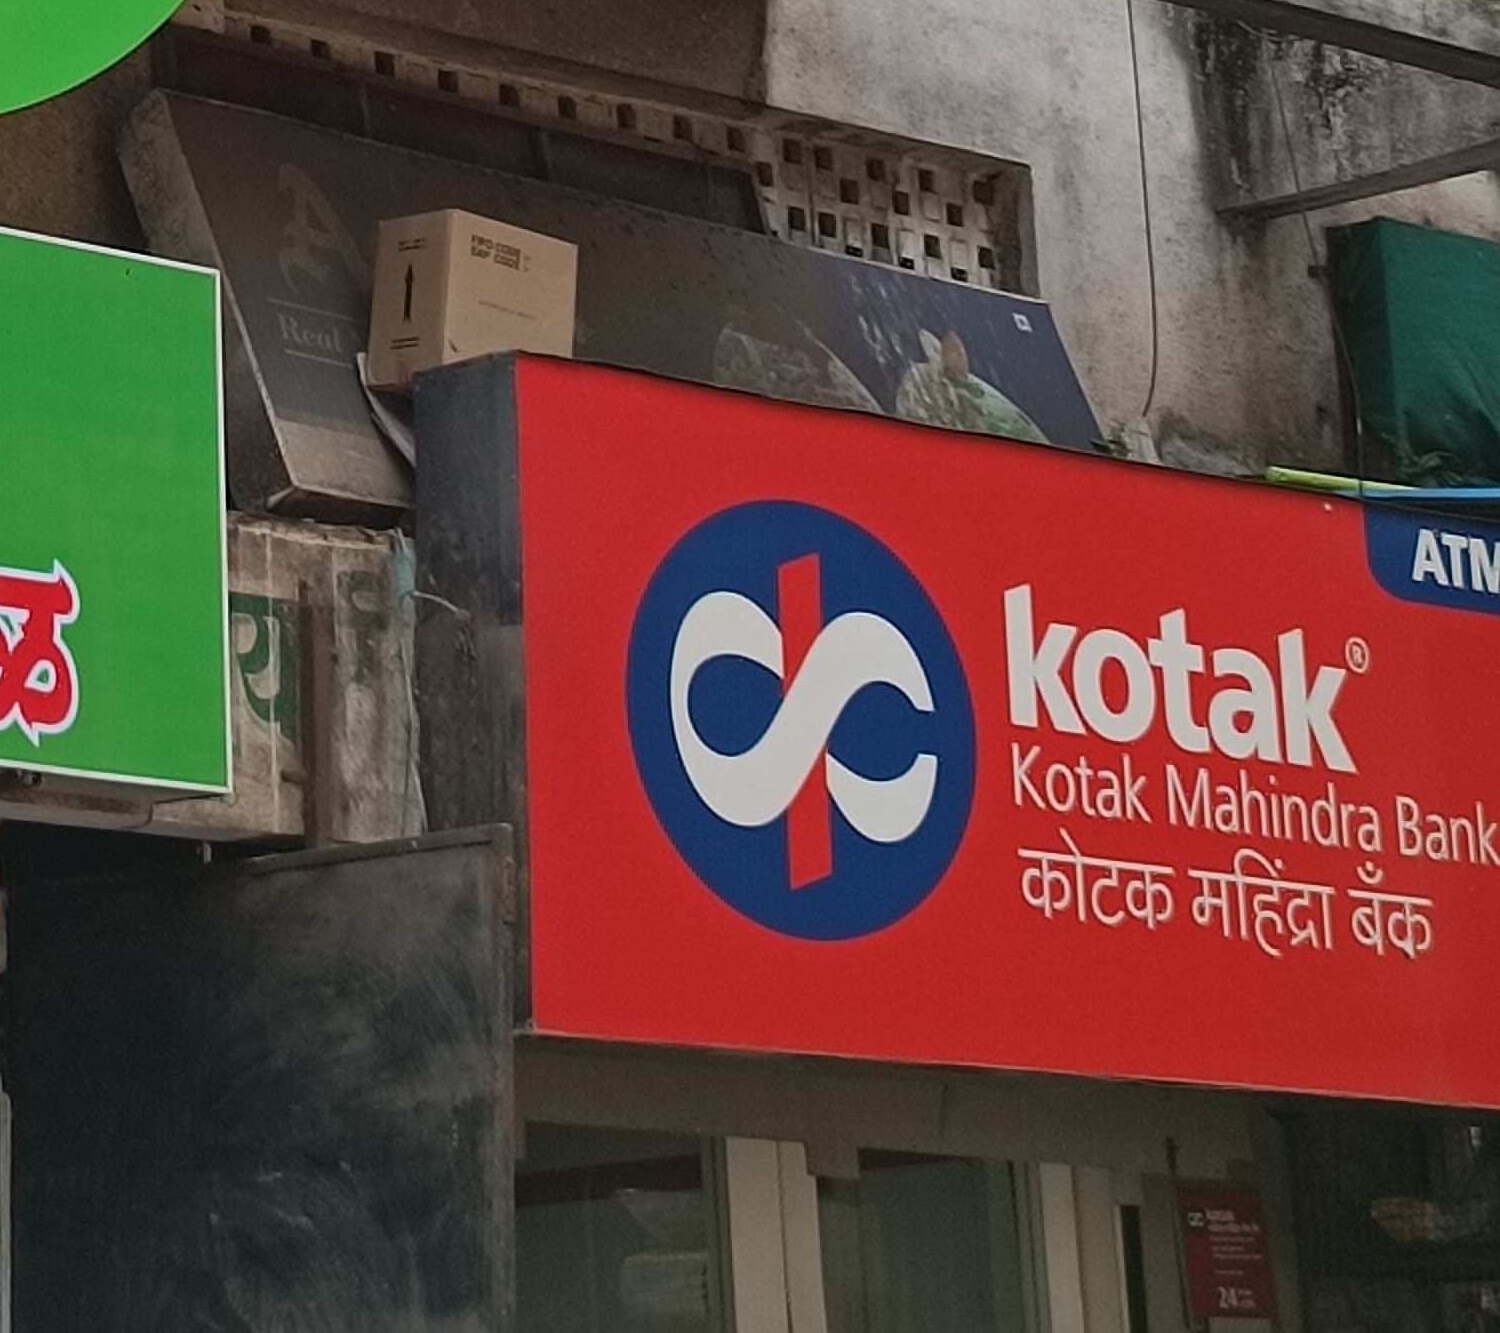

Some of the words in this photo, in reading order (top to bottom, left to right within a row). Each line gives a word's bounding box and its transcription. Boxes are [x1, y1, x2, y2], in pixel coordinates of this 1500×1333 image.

[1411, 527, 1500, 595] ATM
[1003, 583, 1358, 774] kotak
[1011, 741, 1152, 823] Kotak
[1166, 763, 1382, 853] Mahindra
[1396, 795, 1500, 867] Bank
[1017, 828, 1175, 930] कोटक
[1187, 848, 1336, 958] महिंद्रा
